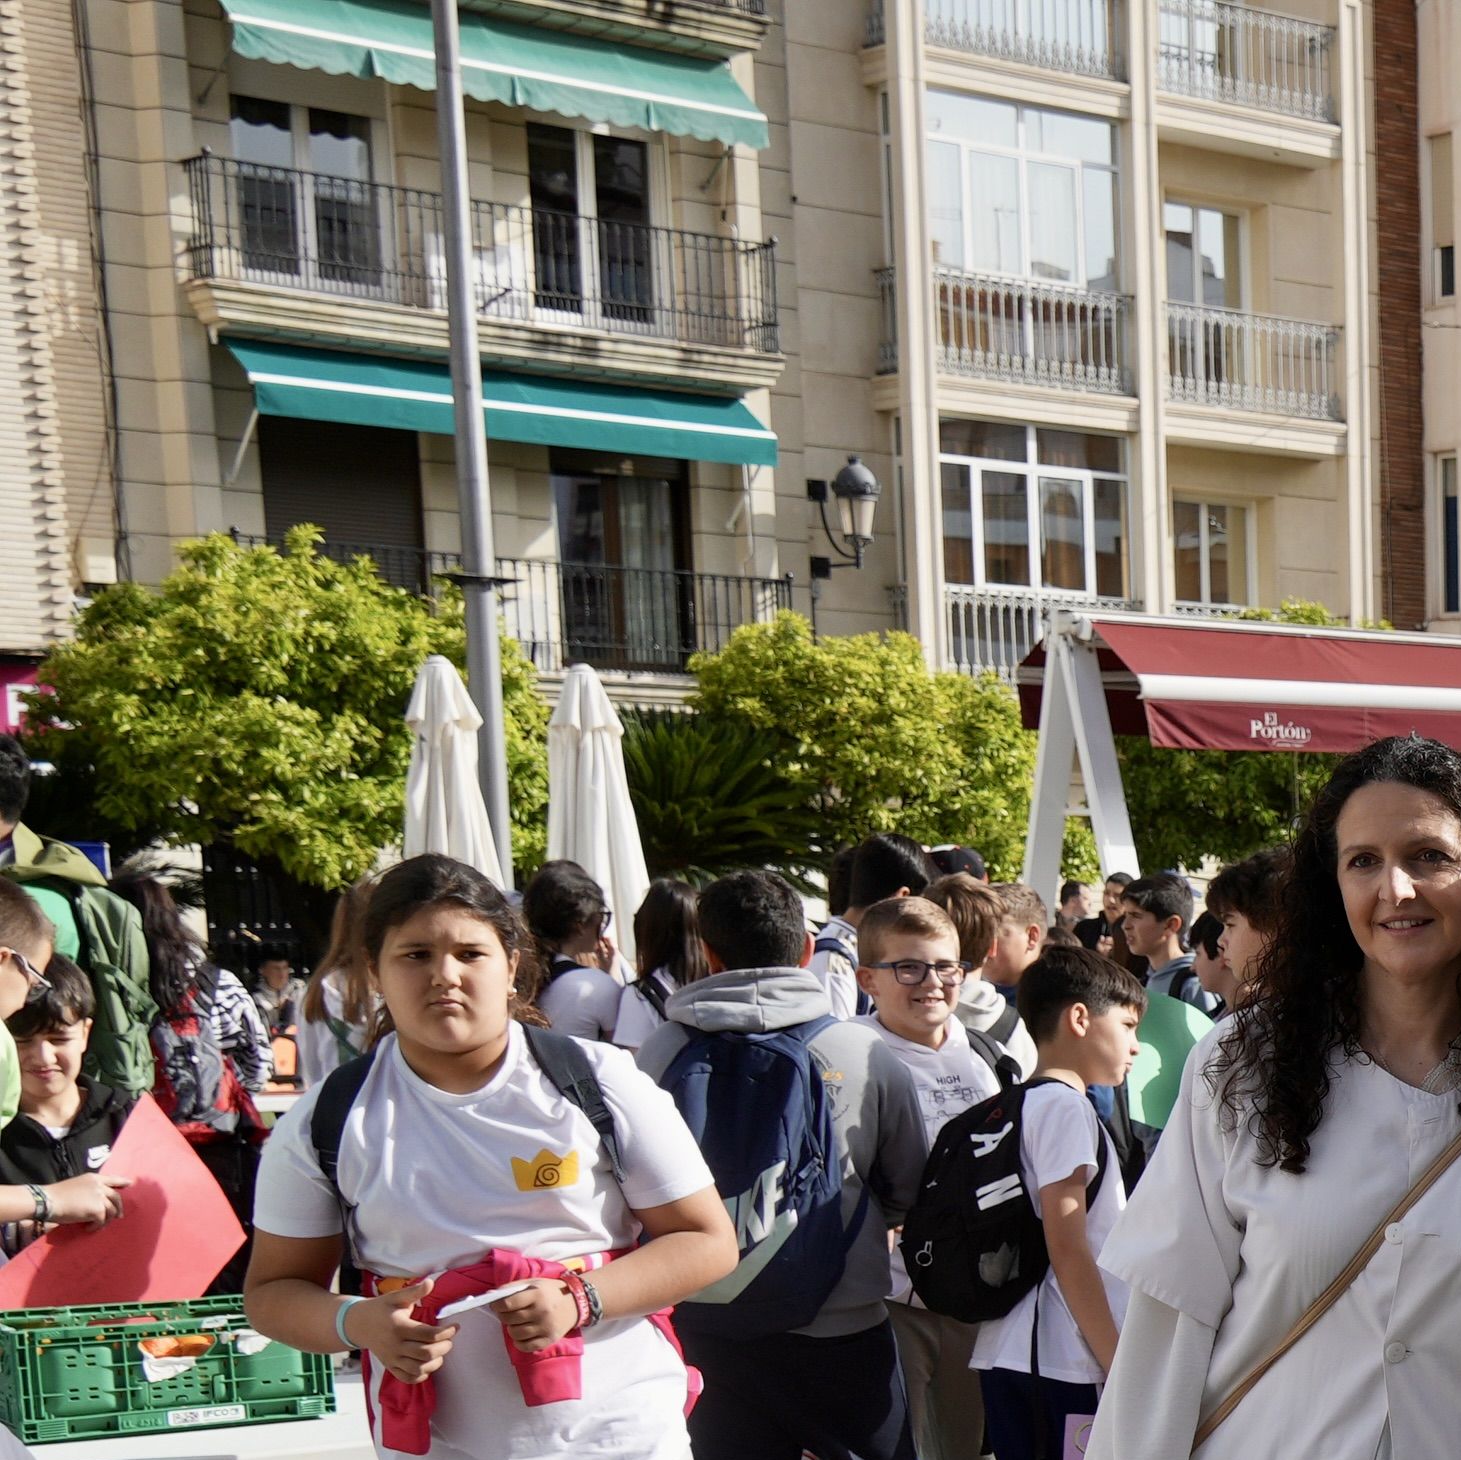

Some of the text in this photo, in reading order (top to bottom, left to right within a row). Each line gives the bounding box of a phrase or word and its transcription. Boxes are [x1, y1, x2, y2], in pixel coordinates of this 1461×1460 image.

[1264, 711, 1278, 726] El
[1249, 719, 1307, 740] Portón
[935, 1074, 962, 1085] HIGH
